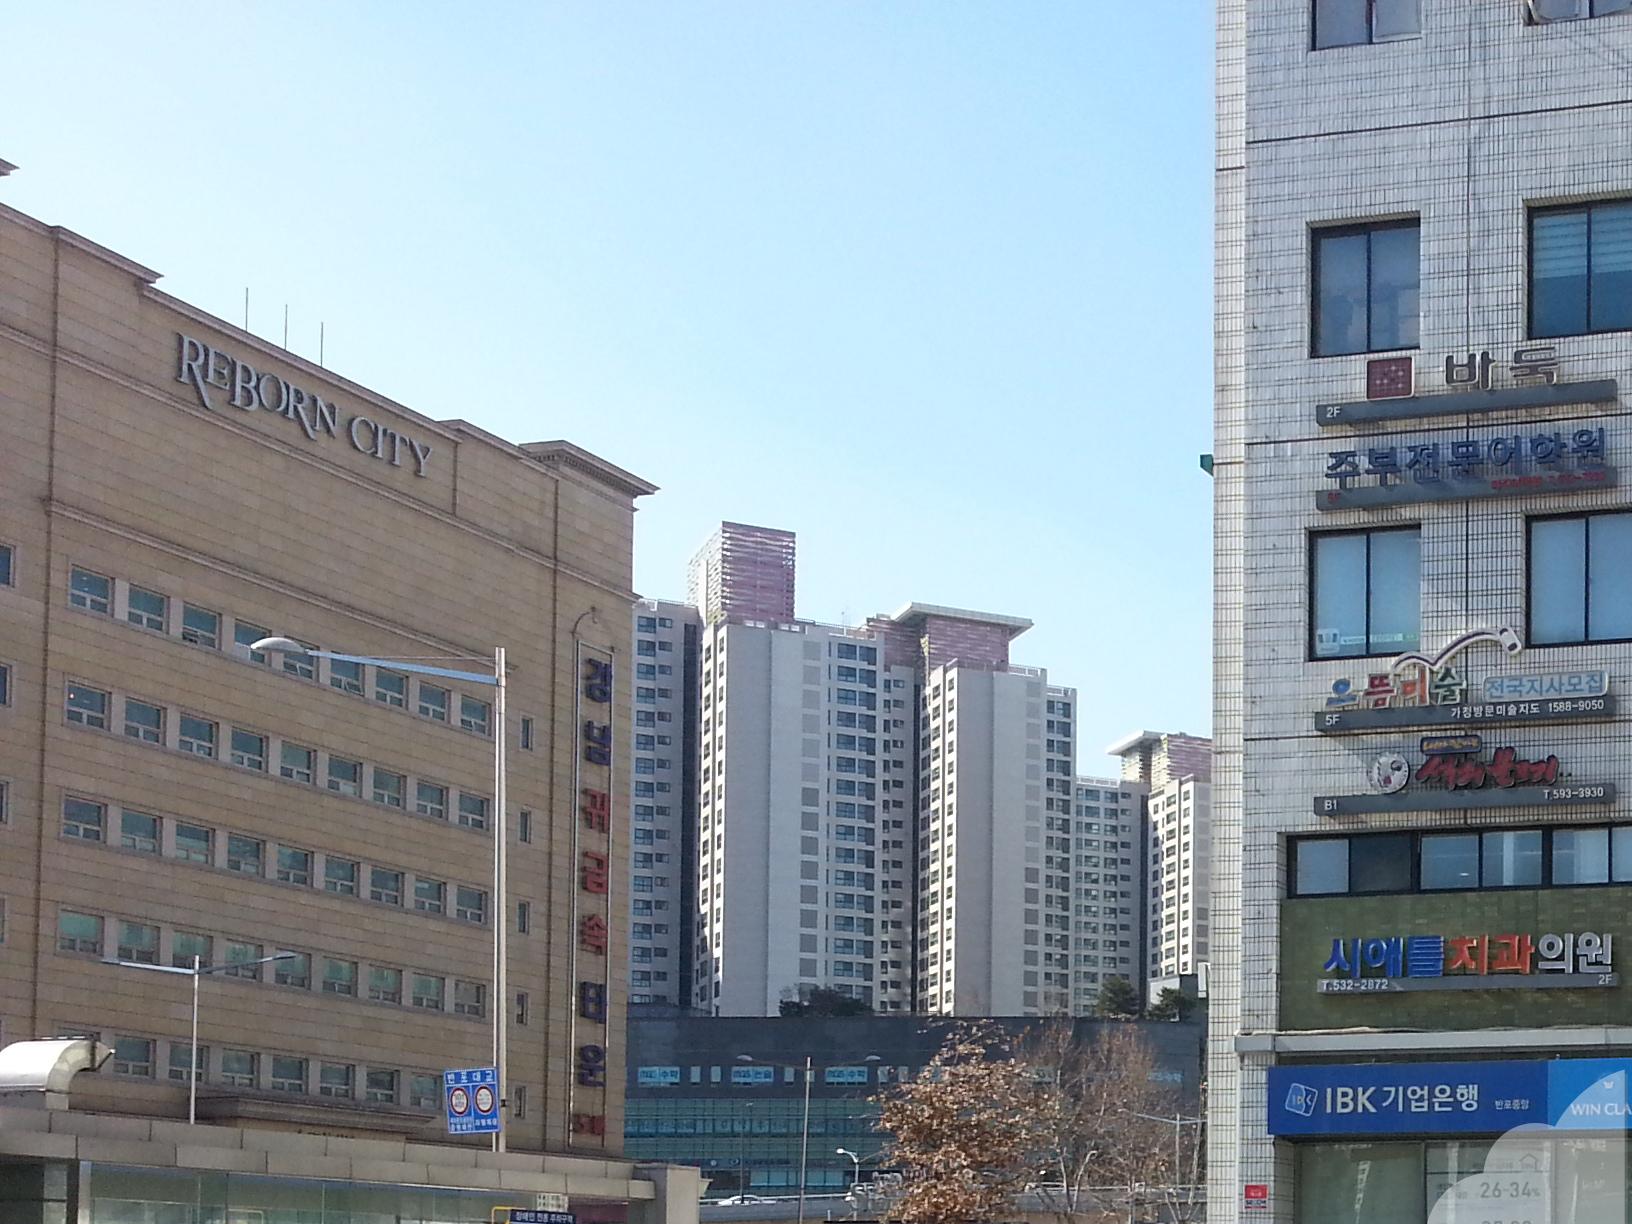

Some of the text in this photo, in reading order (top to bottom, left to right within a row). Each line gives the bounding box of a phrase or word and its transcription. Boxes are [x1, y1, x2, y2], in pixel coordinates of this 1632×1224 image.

[1445, 346, 1560, 390] 바둑
[176, 332, 434, 477] REBORN CITY
[1325, 406, 1341, 419] 2F
[1548, 700, 1605, 713] 1588-9050
[1325, 714, 1340, 726] 5F
[1544, 787, 1605, 801] T.593-3930
[1324, 800, 1338, 811] B1
[1598, 974, 1613, 985] 2F
[1325, 1086, 1378, 1114] IBK
[1382, 1083, 1480, 1113] 기업은행
[1570, 1103, 1601, 1116] WIN
